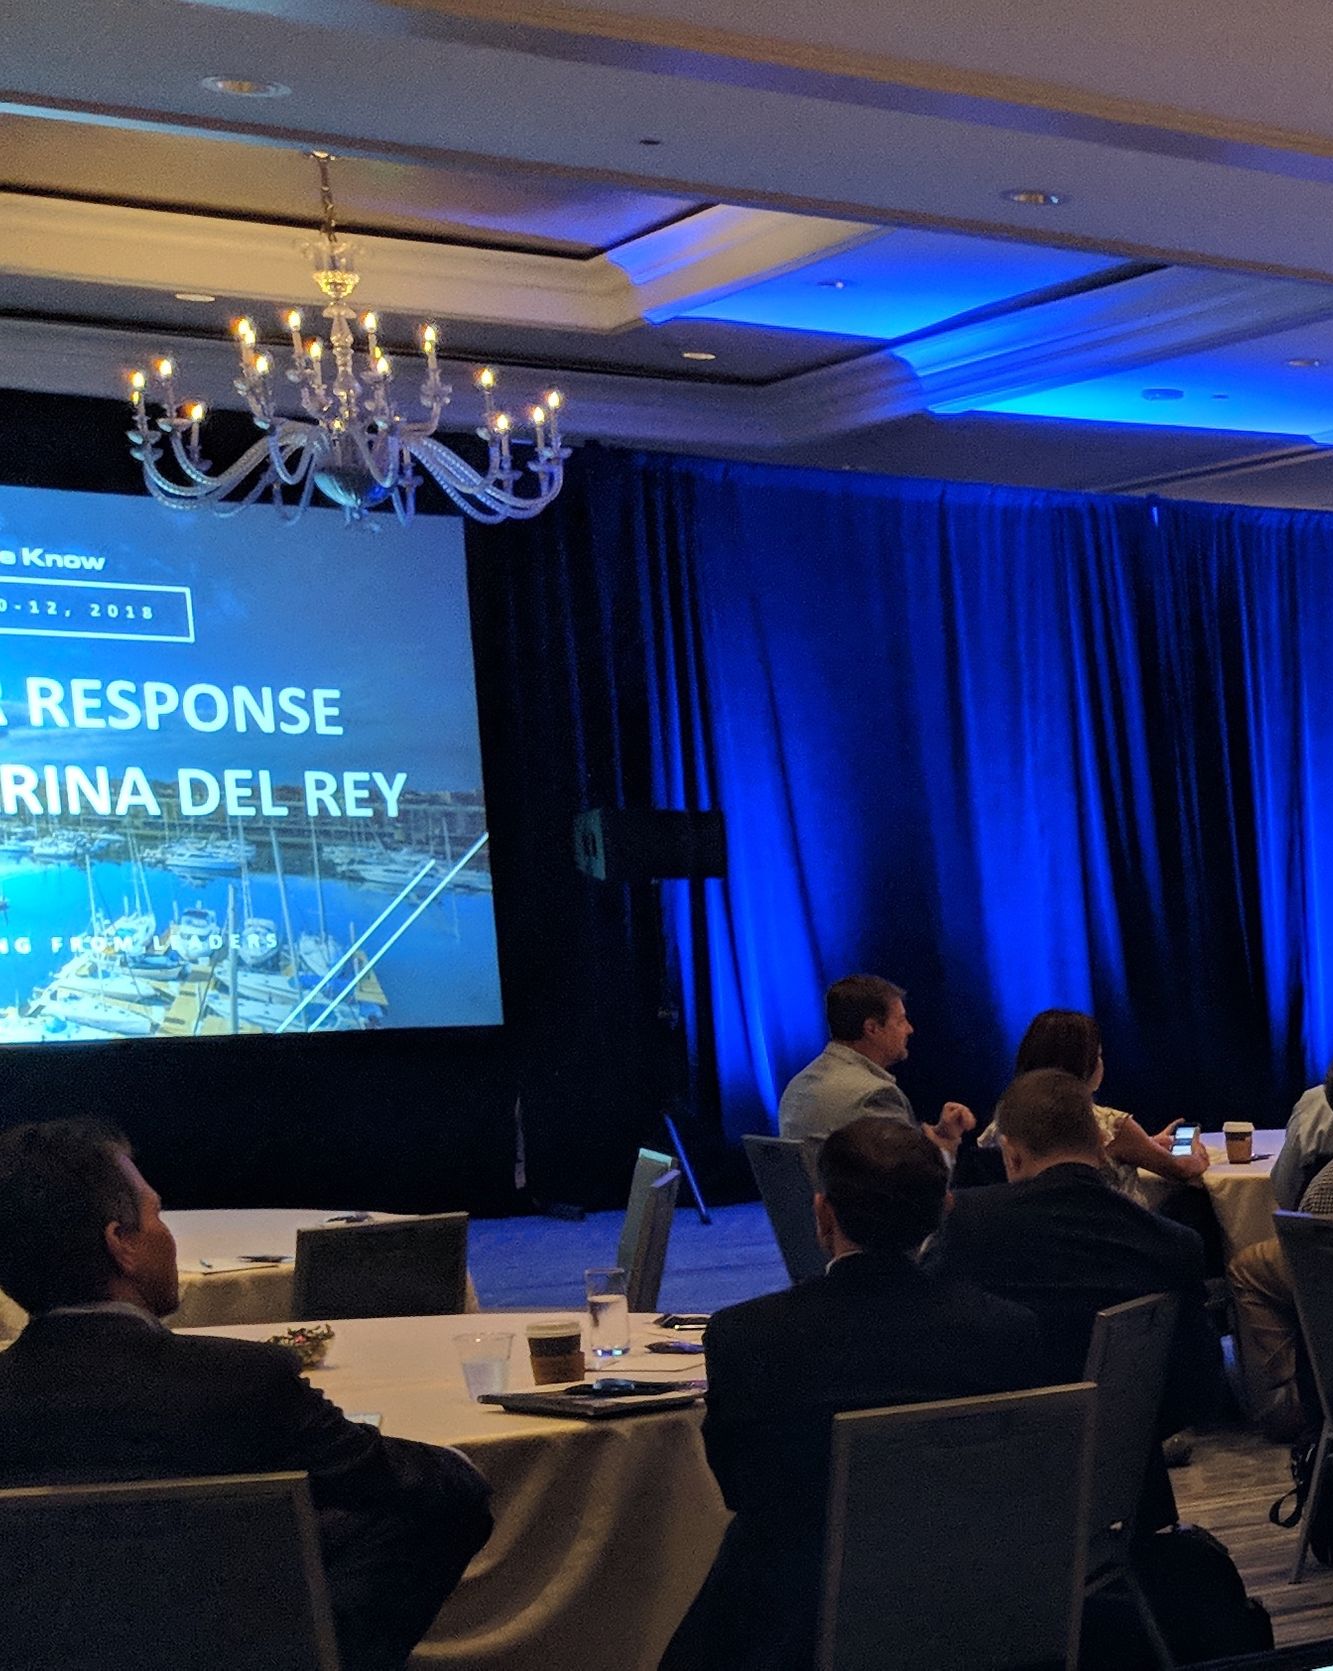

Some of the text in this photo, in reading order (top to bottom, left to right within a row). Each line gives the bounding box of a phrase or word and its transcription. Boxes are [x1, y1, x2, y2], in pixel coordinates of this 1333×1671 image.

[21, 547, 106, 571] Know
[90, 603, 153, 620] 2018
[25, 676, 344, 736] RESPONSE
[177, 767, 289, 818] DEL
[303, 770, 408, 819] REY
